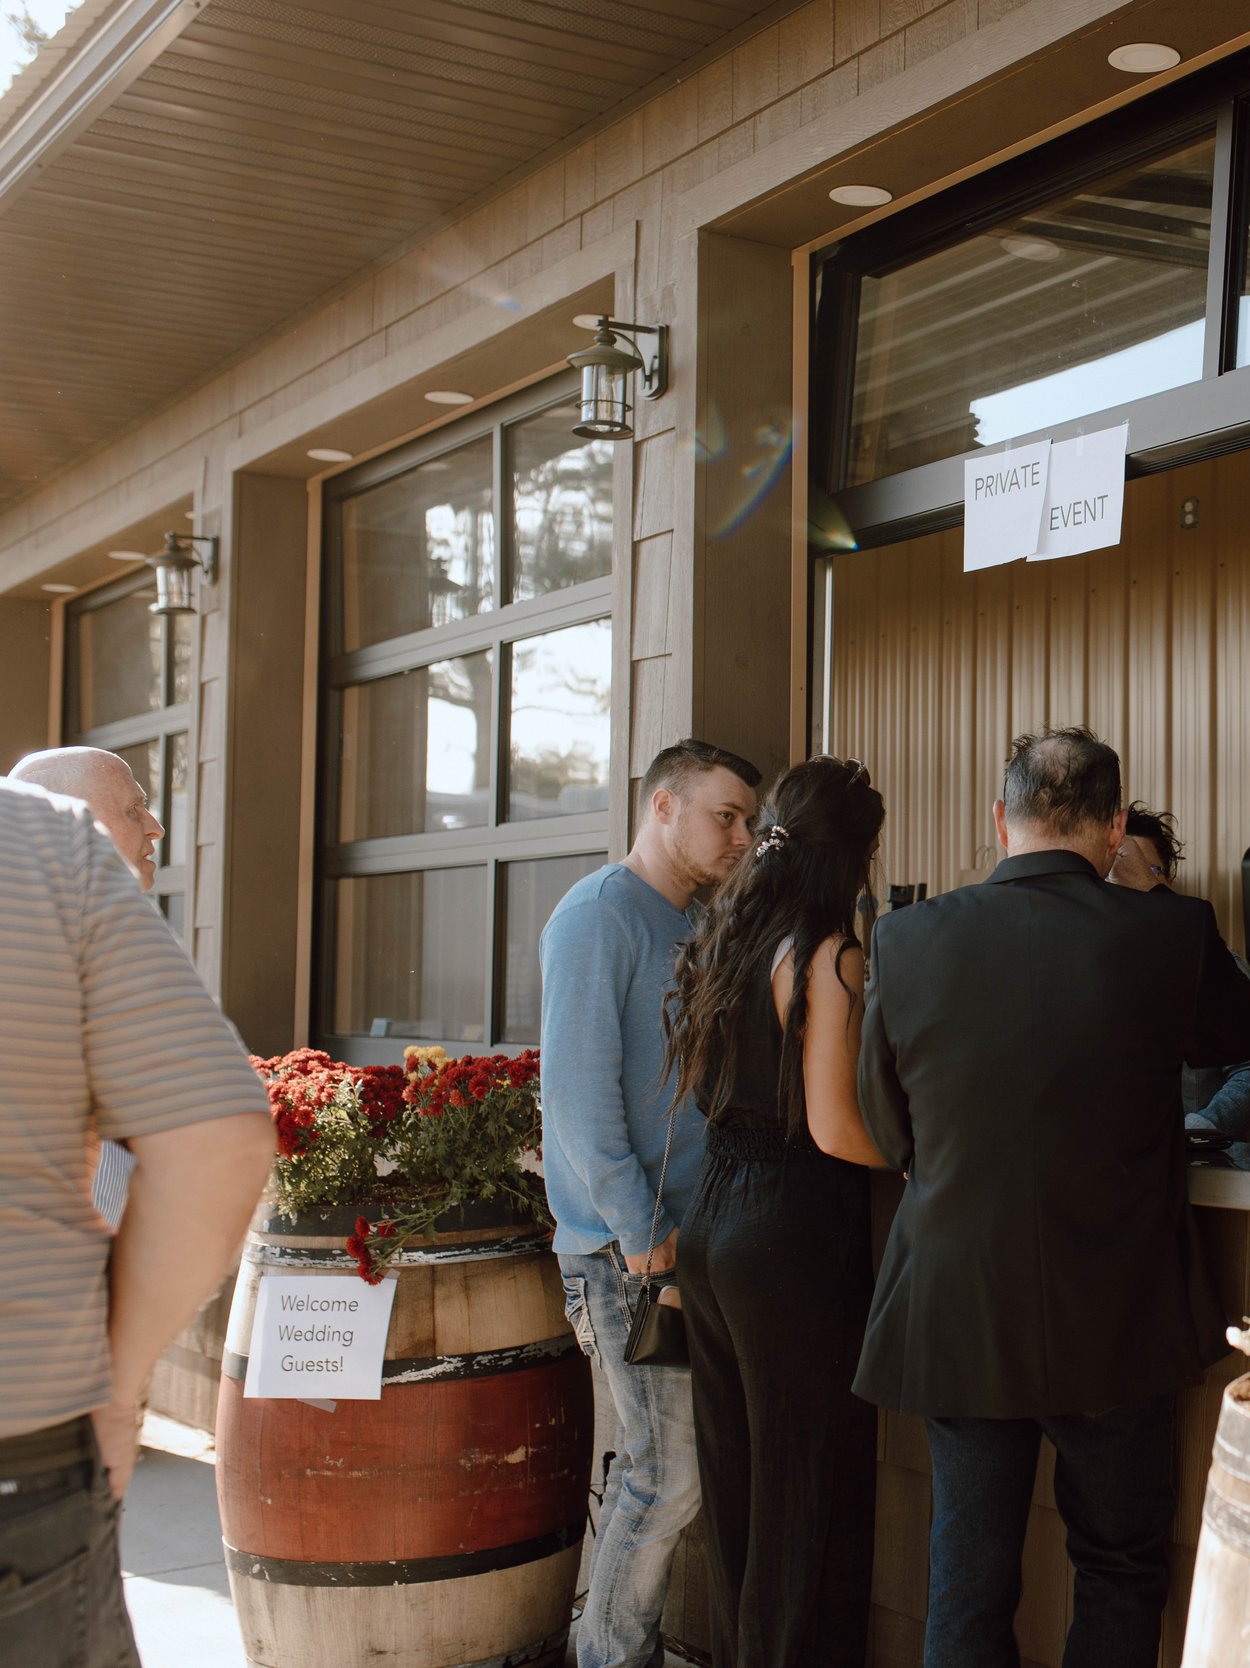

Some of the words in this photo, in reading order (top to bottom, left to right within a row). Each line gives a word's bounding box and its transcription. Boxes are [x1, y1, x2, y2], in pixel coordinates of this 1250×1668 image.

[975, 461, 1040, 500] PRIVATE
[1049, 494, 1109, 531] EVENT
[281, 1294, 359, 1312] Welcome
[278, 1324, 354, 1347] Wedding
[281, 1354, 344, 1372] Guests!
